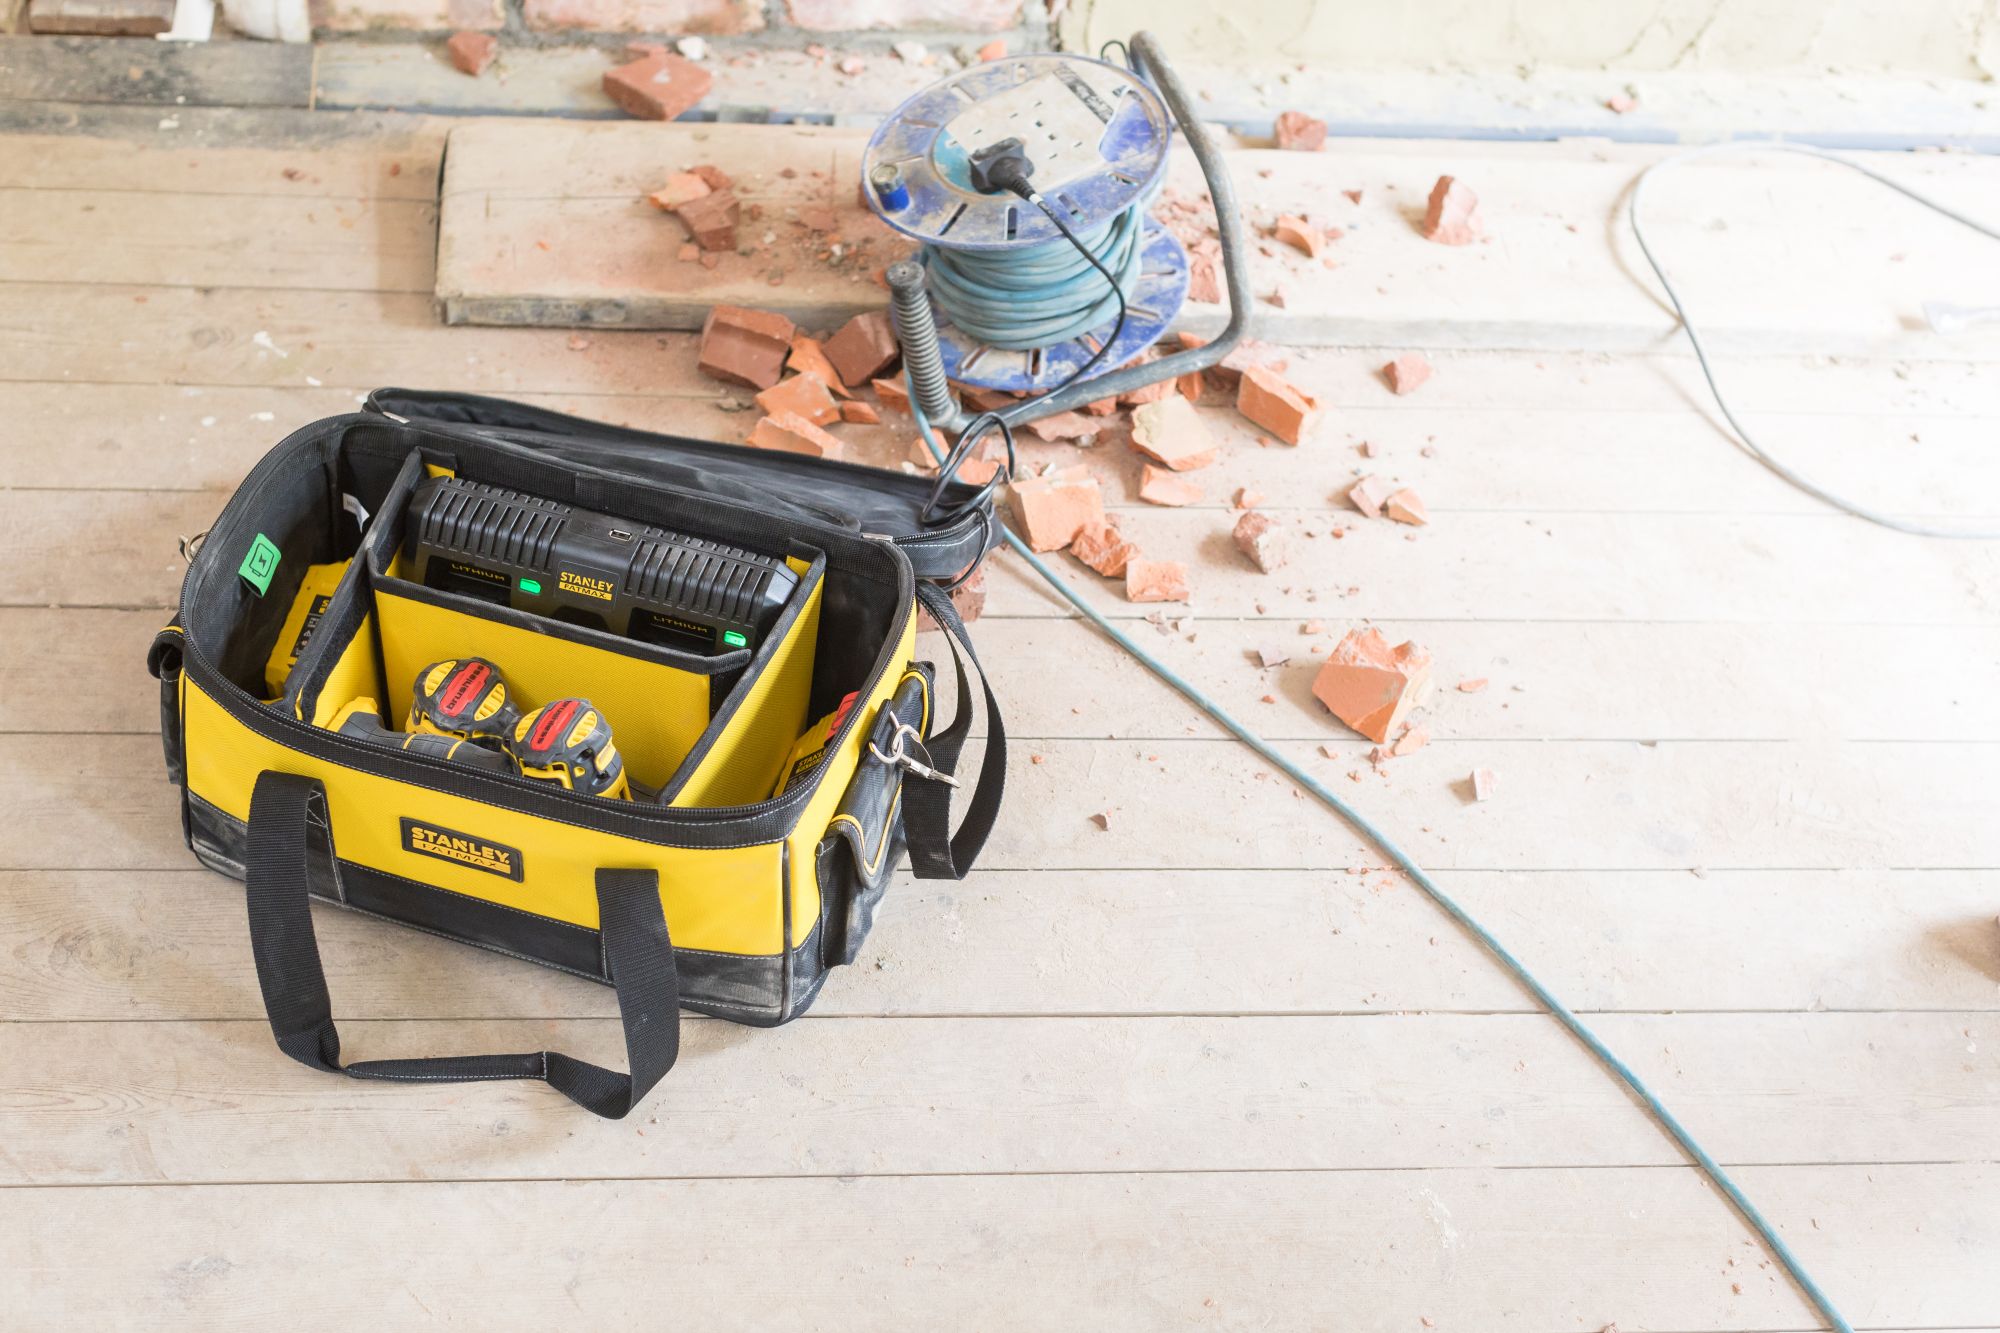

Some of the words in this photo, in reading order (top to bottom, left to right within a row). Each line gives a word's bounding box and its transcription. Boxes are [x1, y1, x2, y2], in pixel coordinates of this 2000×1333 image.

[451, 563, 505, 581] LITHIUM
[560, 571, 614, 592] STANLEY
[562, 583, 608, 599] FATMAX
[653, 615, 708, 633] LITHIUM
[418, 841, 502, 870] FATMAX
